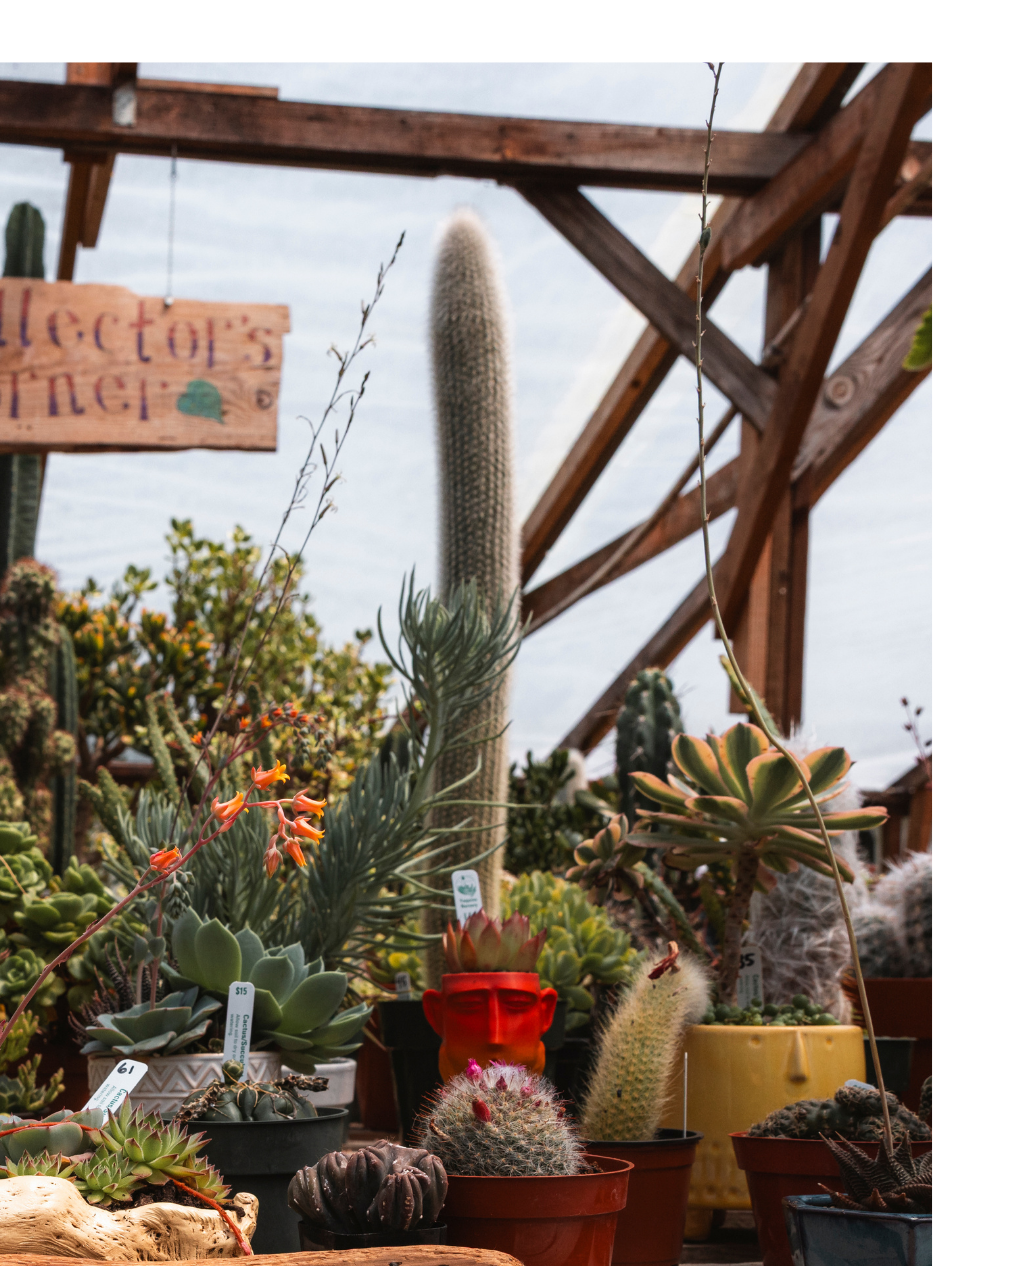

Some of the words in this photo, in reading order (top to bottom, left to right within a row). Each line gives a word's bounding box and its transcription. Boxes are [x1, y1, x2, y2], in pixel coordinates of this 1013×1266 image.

[235, 986, 248, 996] $15
[239, 1014, 250, 1077] Cactus/Succu
[117, 1062, 135, 1075] 61
